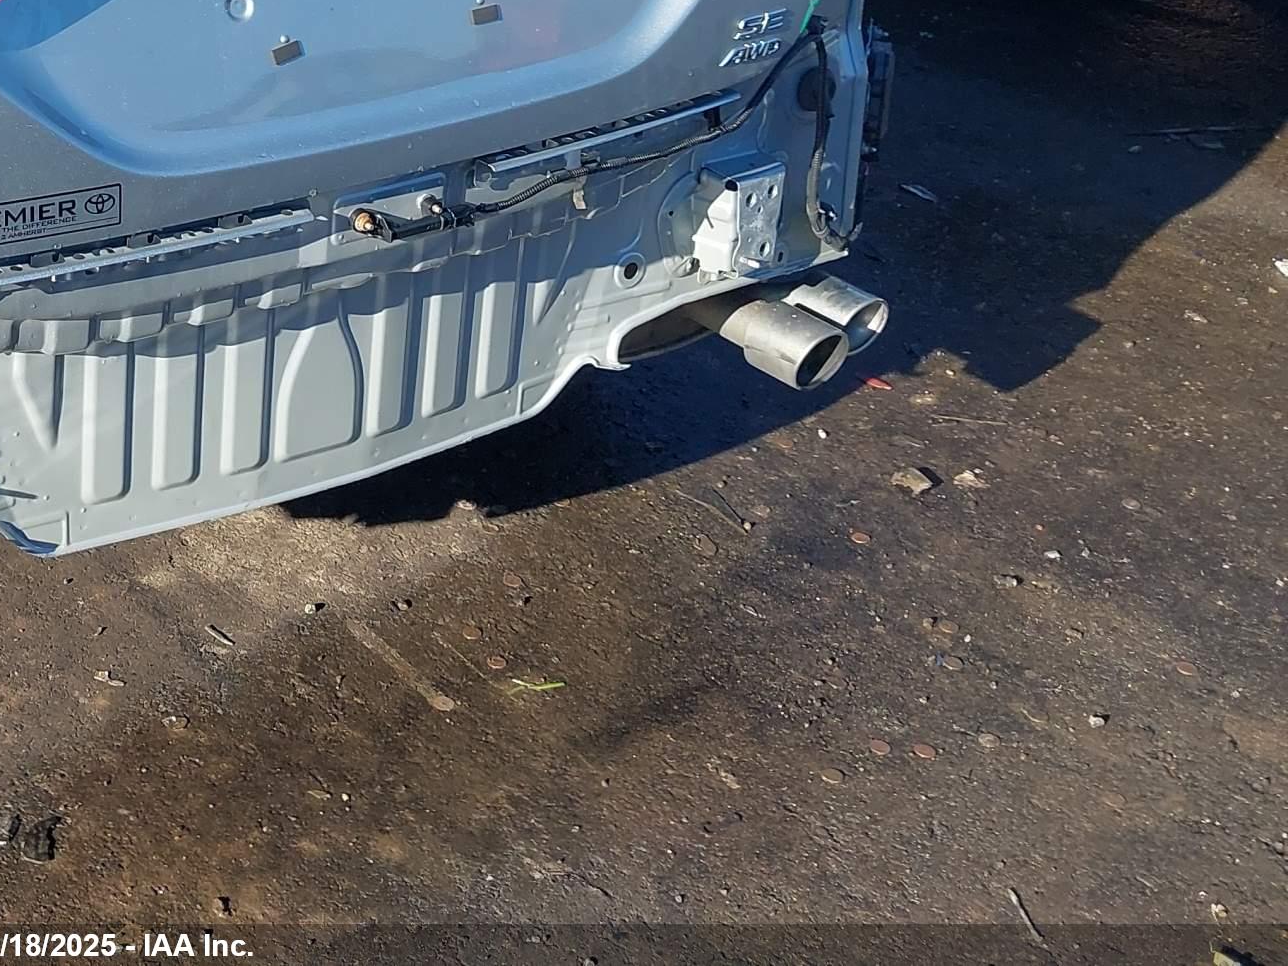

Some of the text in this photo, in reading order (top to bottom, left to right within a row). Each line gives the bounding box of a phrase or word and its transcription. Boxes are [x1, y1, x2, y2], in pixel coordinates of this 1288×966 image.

[733, 8, 787, 40] SE
[718, 38, 782, 67] AWD
[3, 225, 18, 233] THE
[21, 215, 78, 231] DIFFERENCE
